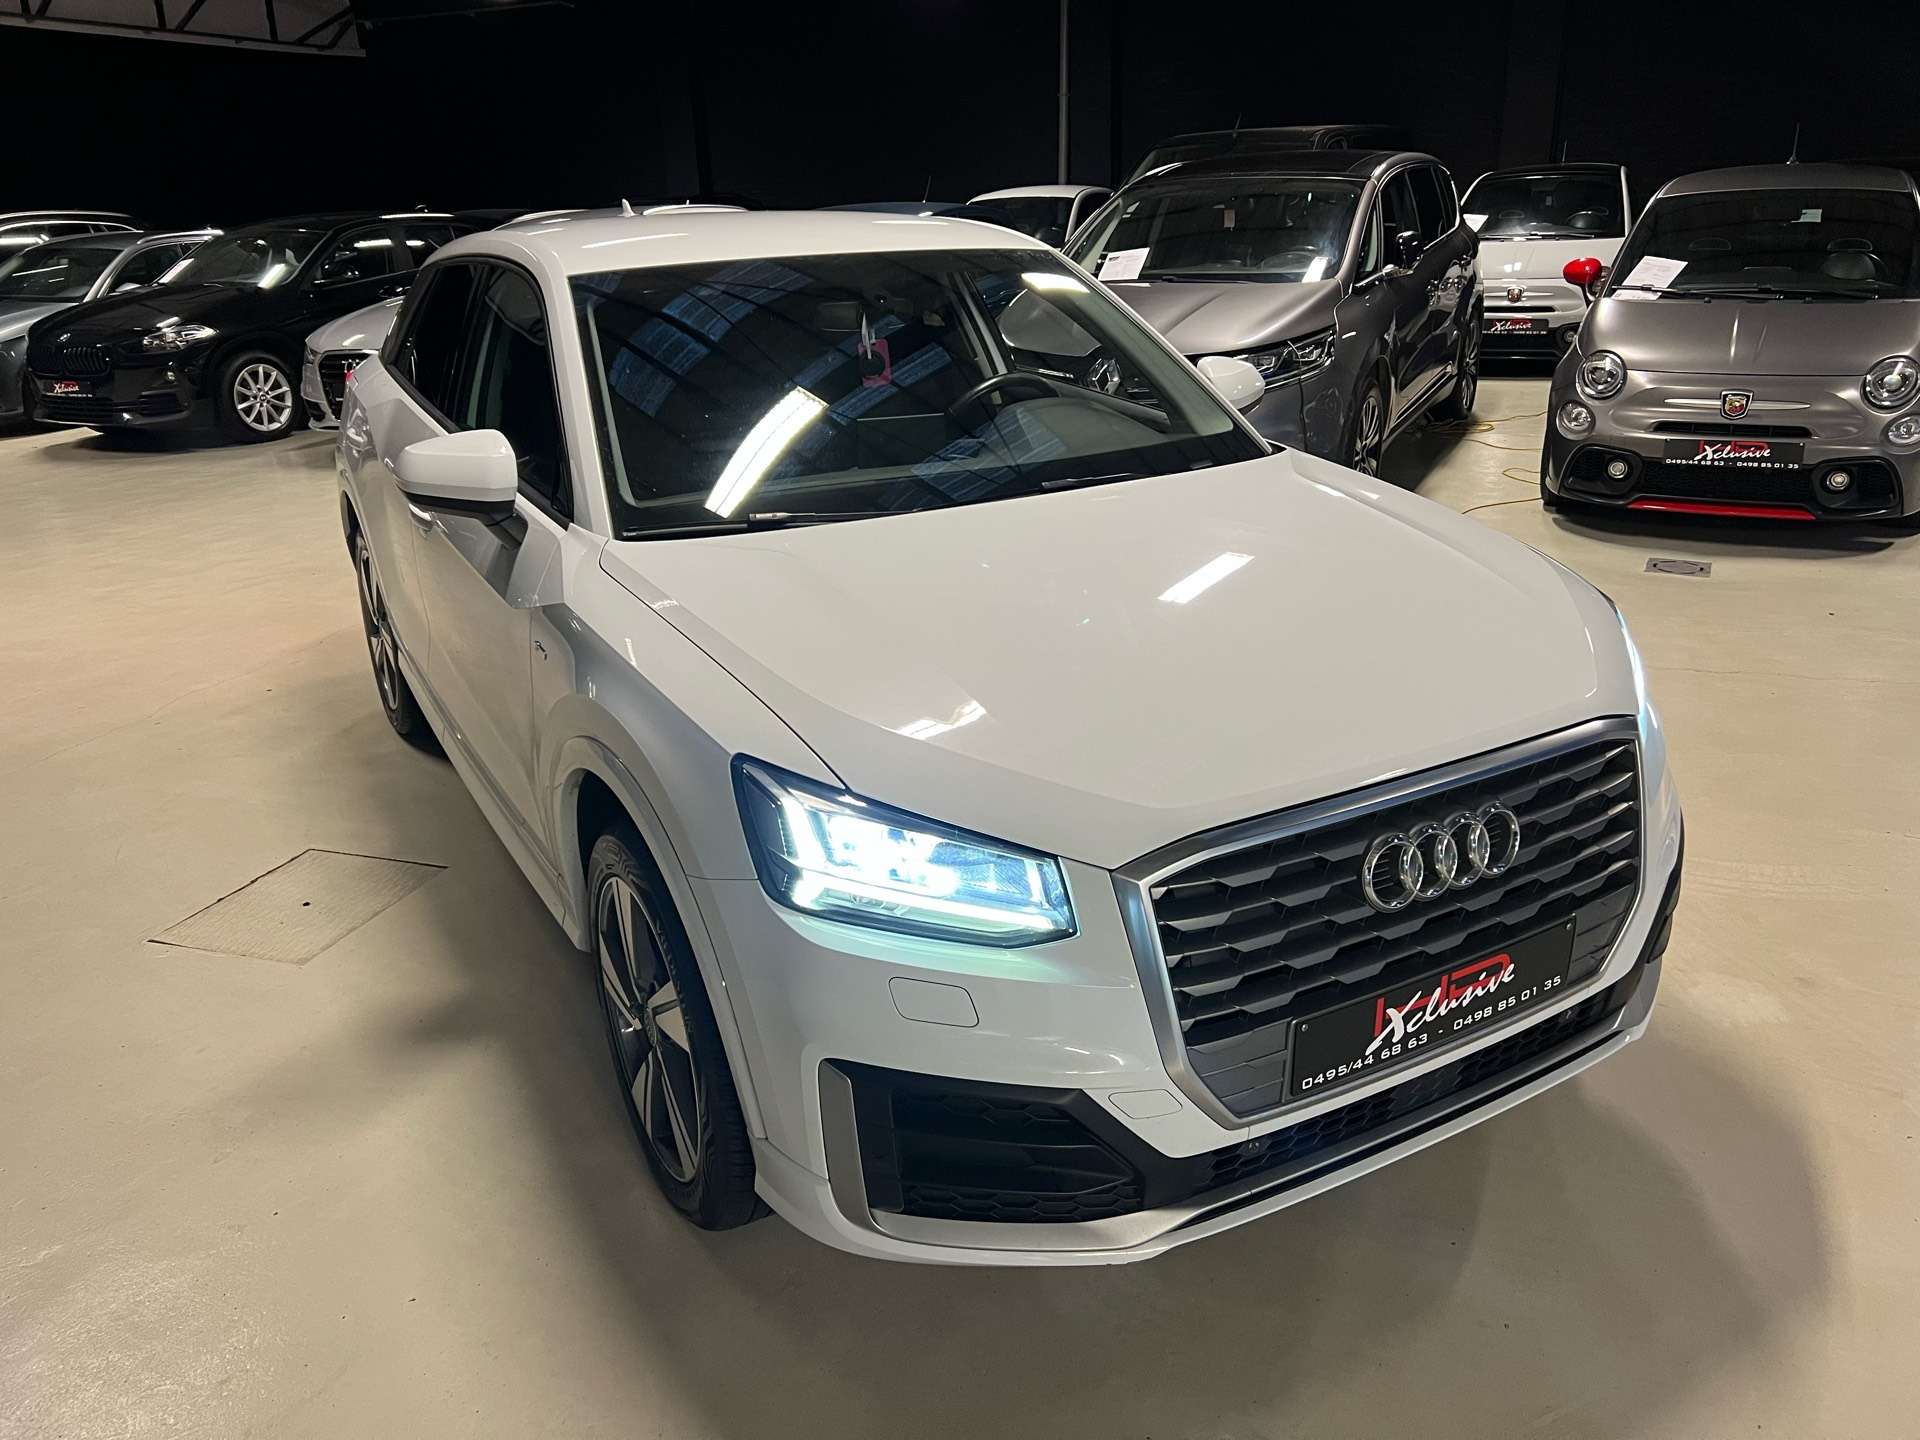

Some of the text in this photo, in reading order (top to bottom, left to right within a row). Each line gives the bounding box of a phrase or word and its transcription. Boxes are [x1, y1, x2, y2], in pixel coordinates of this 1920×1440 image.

[1693, 443, 1771, 461] Xclusive
[1302, 1054, 1375, 1090] 0495/44
[1380, 1043, 1402, 1060] 68
[1407, 1033, 1428, 1049] 63
[1453, 1006, 1493, 1031] 0498
[1497, 996, 1516, 1012] 85
[1521, 986, 1537, 1001] 01
[1543, 975, 1561, 991] 35
[1365, 963, 1514, 1056] Xclusive
